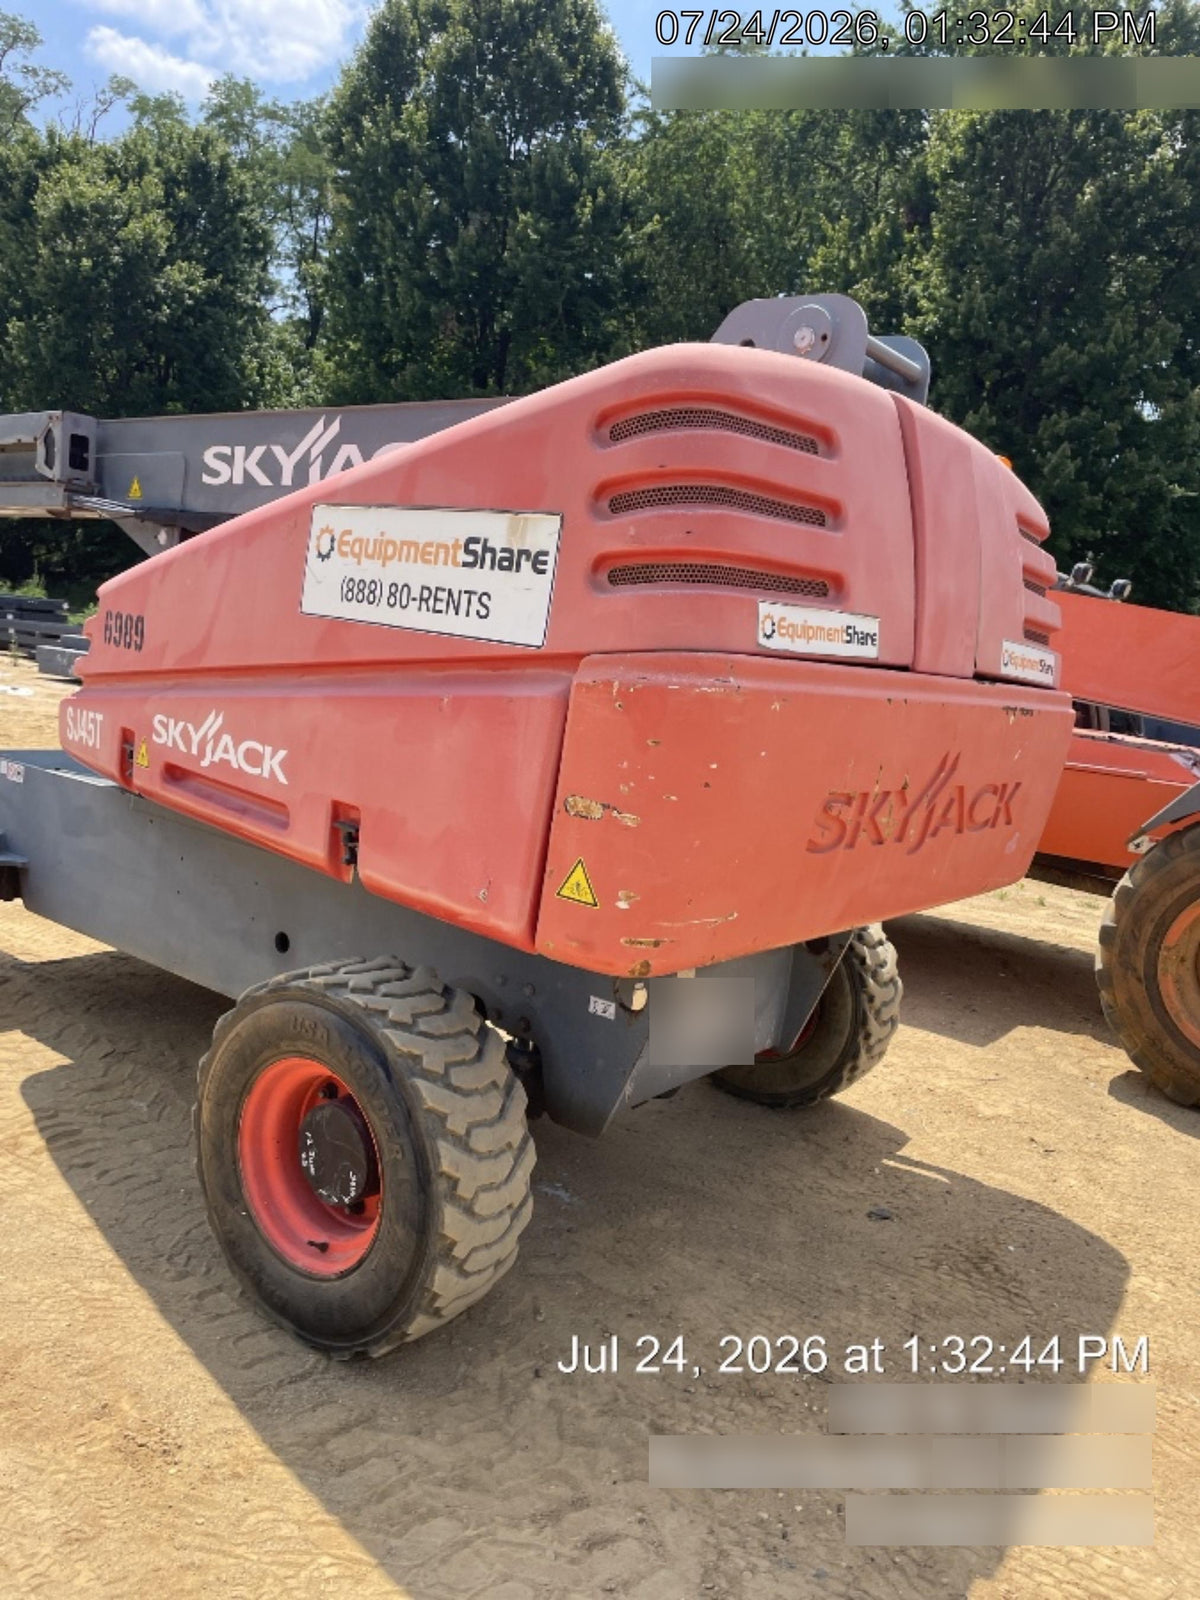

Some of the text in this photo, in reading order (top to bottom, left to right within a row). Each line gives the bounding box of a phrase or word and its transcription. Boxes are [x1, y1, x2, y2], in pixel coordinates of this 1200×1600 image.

[337, 530, 549, 575] EquipmentShare
[340, 575, 491, 620] (888) 80-RENTS
[777, 616, 877, 647] EquipmentShare
[66, 707, 104, 750] SJ45T
[152, 708, 288, 785] SKYJACK
[805, 751, 1022, 856] SKYJACK
